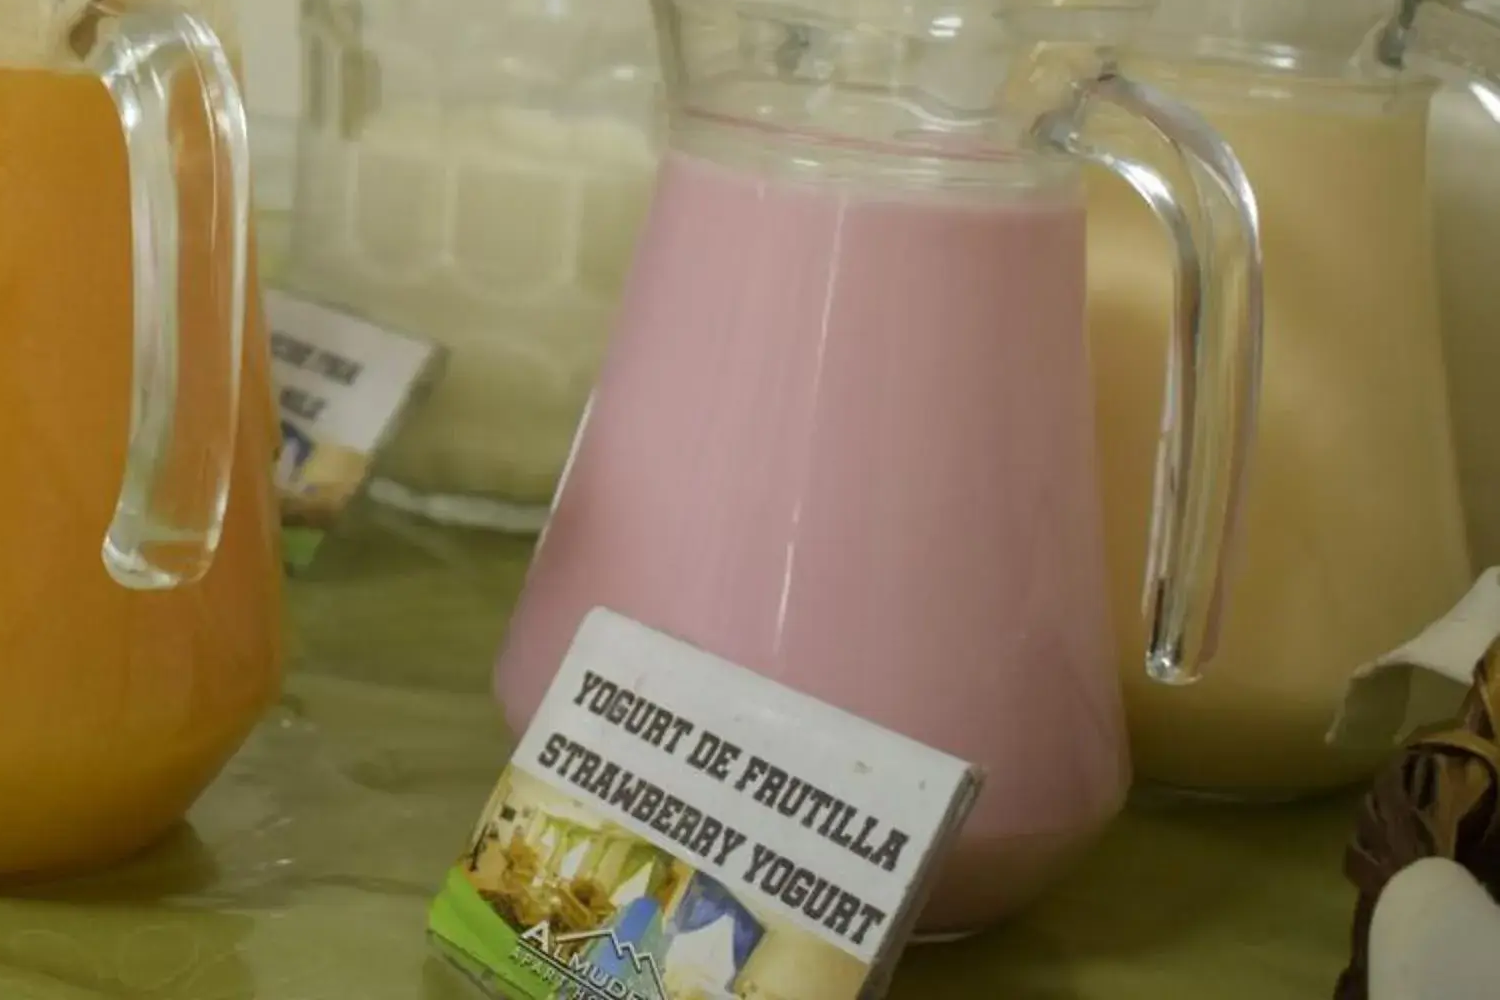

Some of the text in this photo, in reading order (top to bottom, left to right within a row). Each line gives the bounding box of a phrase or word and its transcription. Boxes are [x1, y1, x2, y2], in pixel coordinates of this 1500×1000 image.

[538, 732, 886, 945] STRAWBERRY YOGURT
[572, 669, 911, 873] YOGURT DE FRUTILLA
